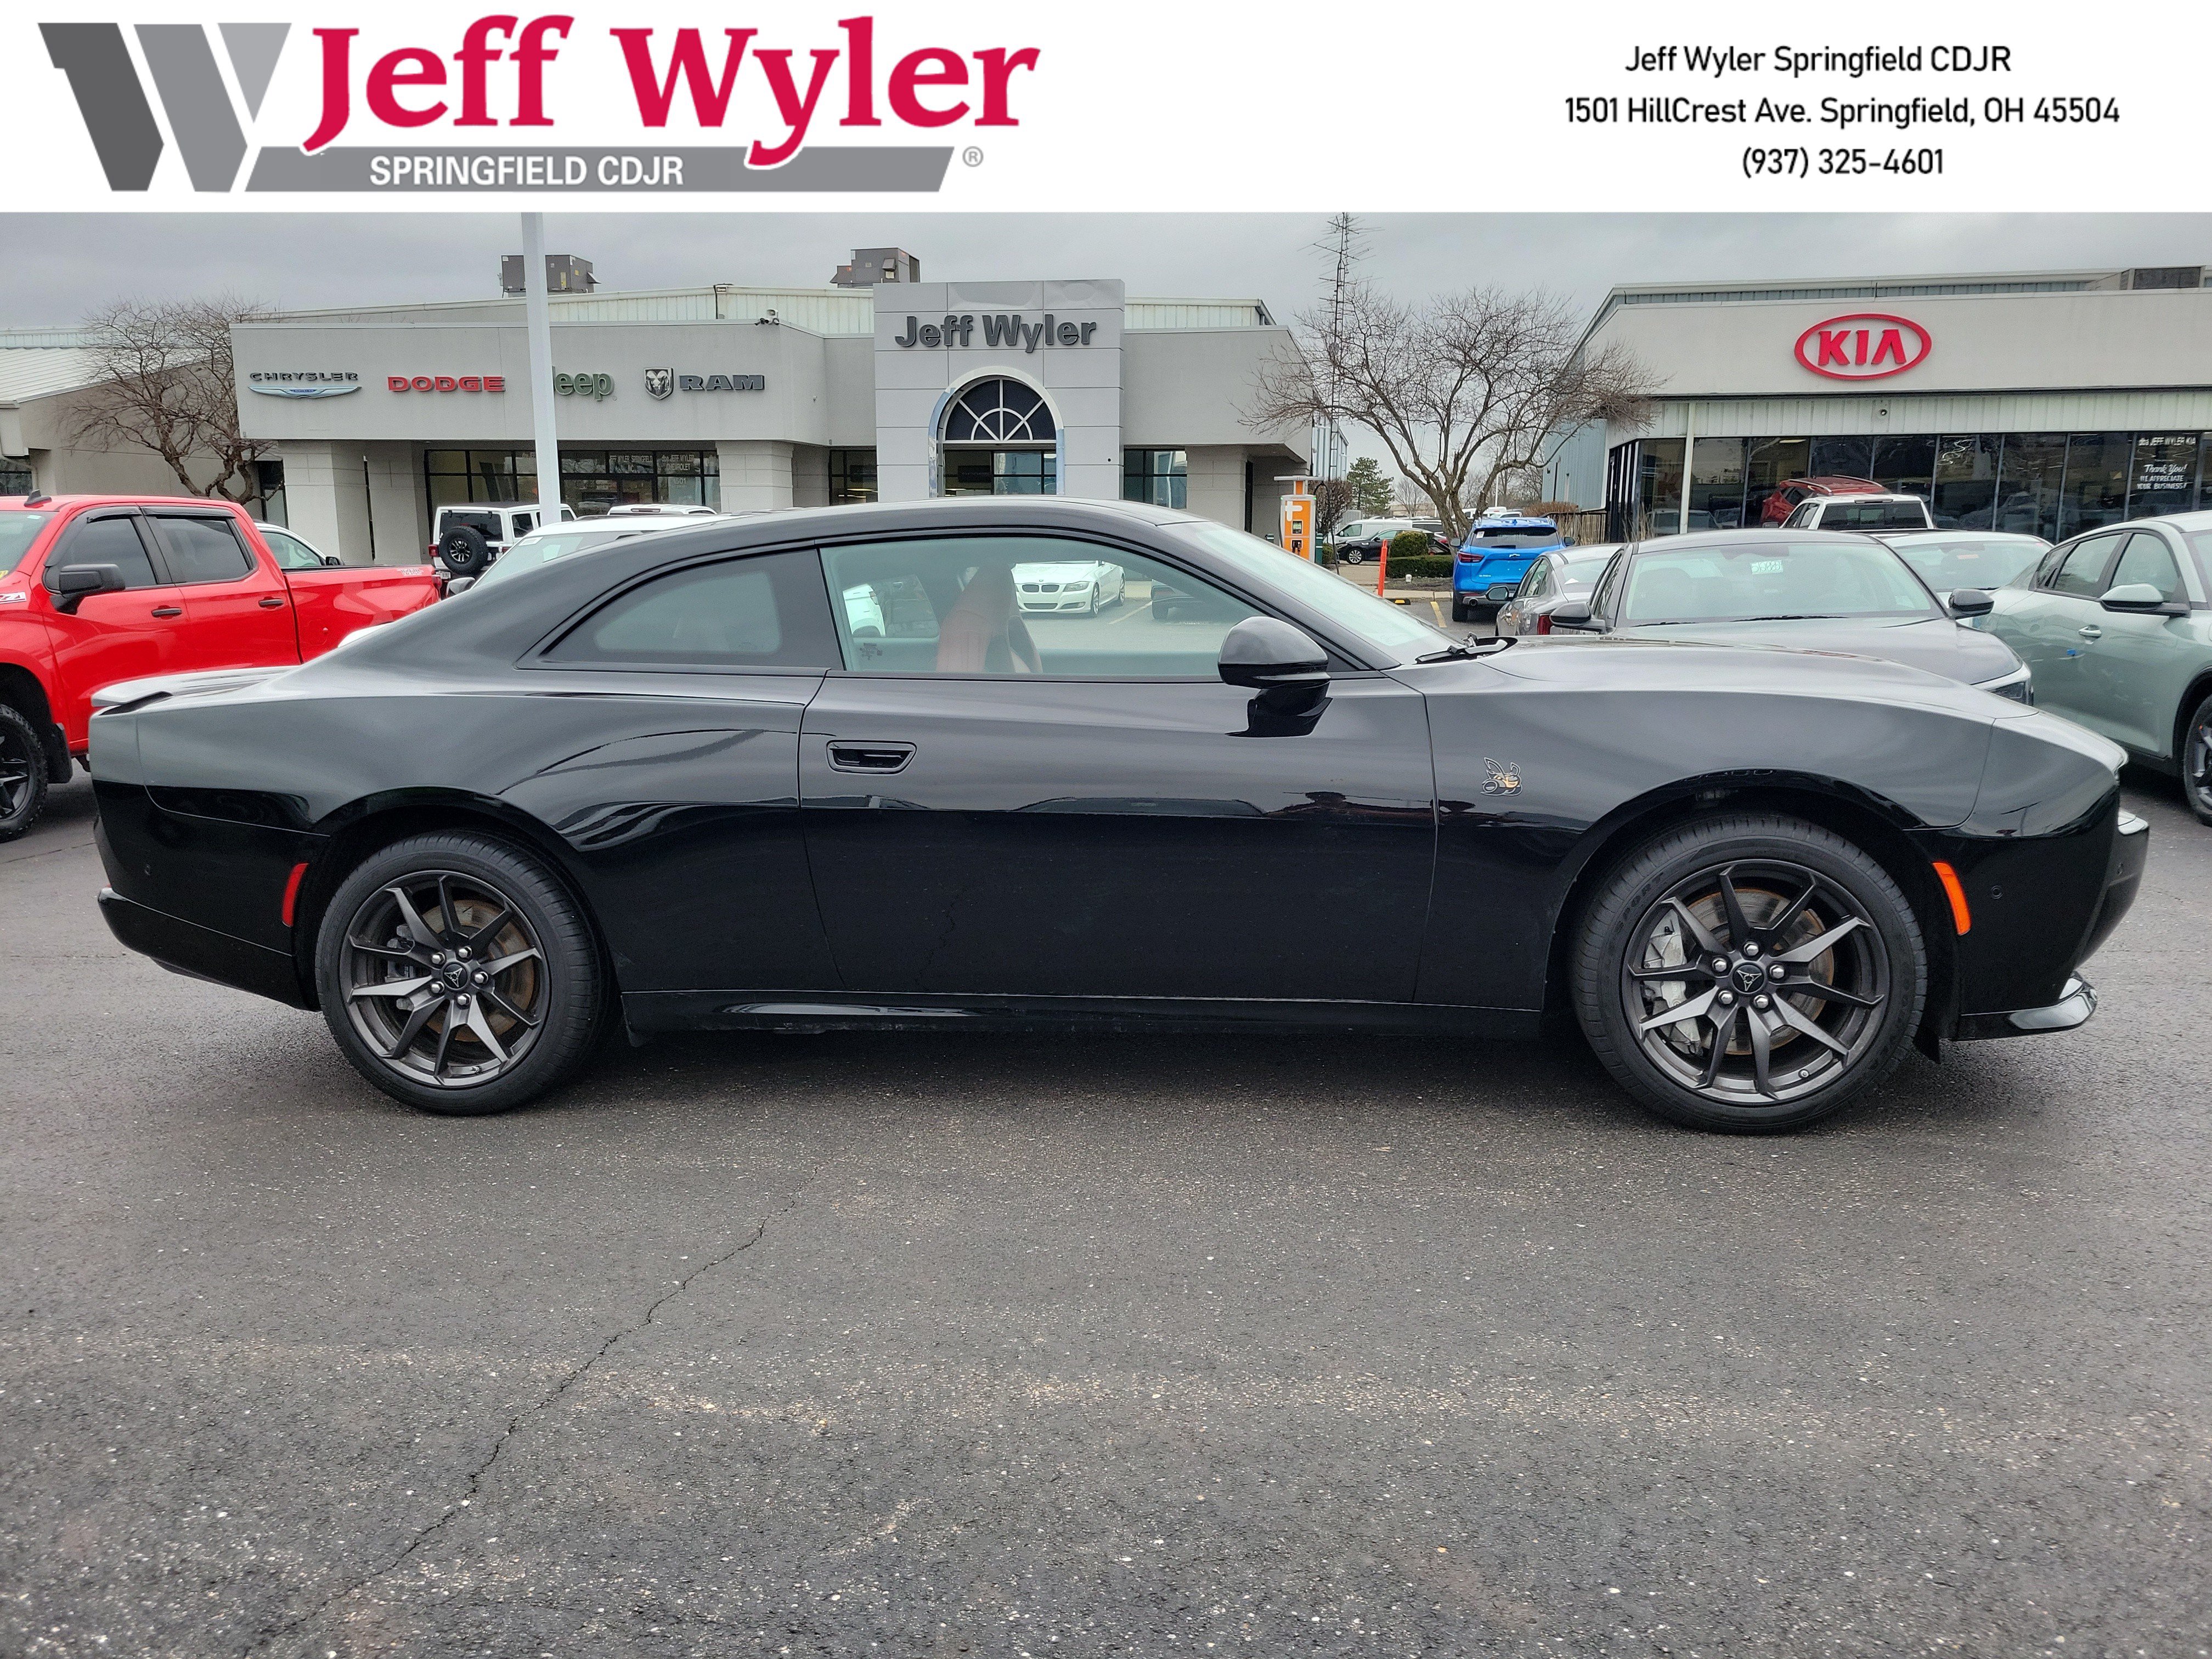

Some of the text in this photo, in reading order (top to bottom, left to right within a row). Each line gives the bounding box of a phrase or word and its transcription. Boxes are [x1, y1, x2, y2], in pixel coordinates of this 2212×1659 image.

[894, 314, 1097, 353] Jeff Wyler
[1818, 329, 1907, 365] KIA
[249, 372, 359, 381] CHRYSLER
[387, 376, 506, 392] DODGE
[552, 366, 615, 402] eep
[678, 374, 766, 391] RAM
[2143, 464, 2188, 475] Thank You!
